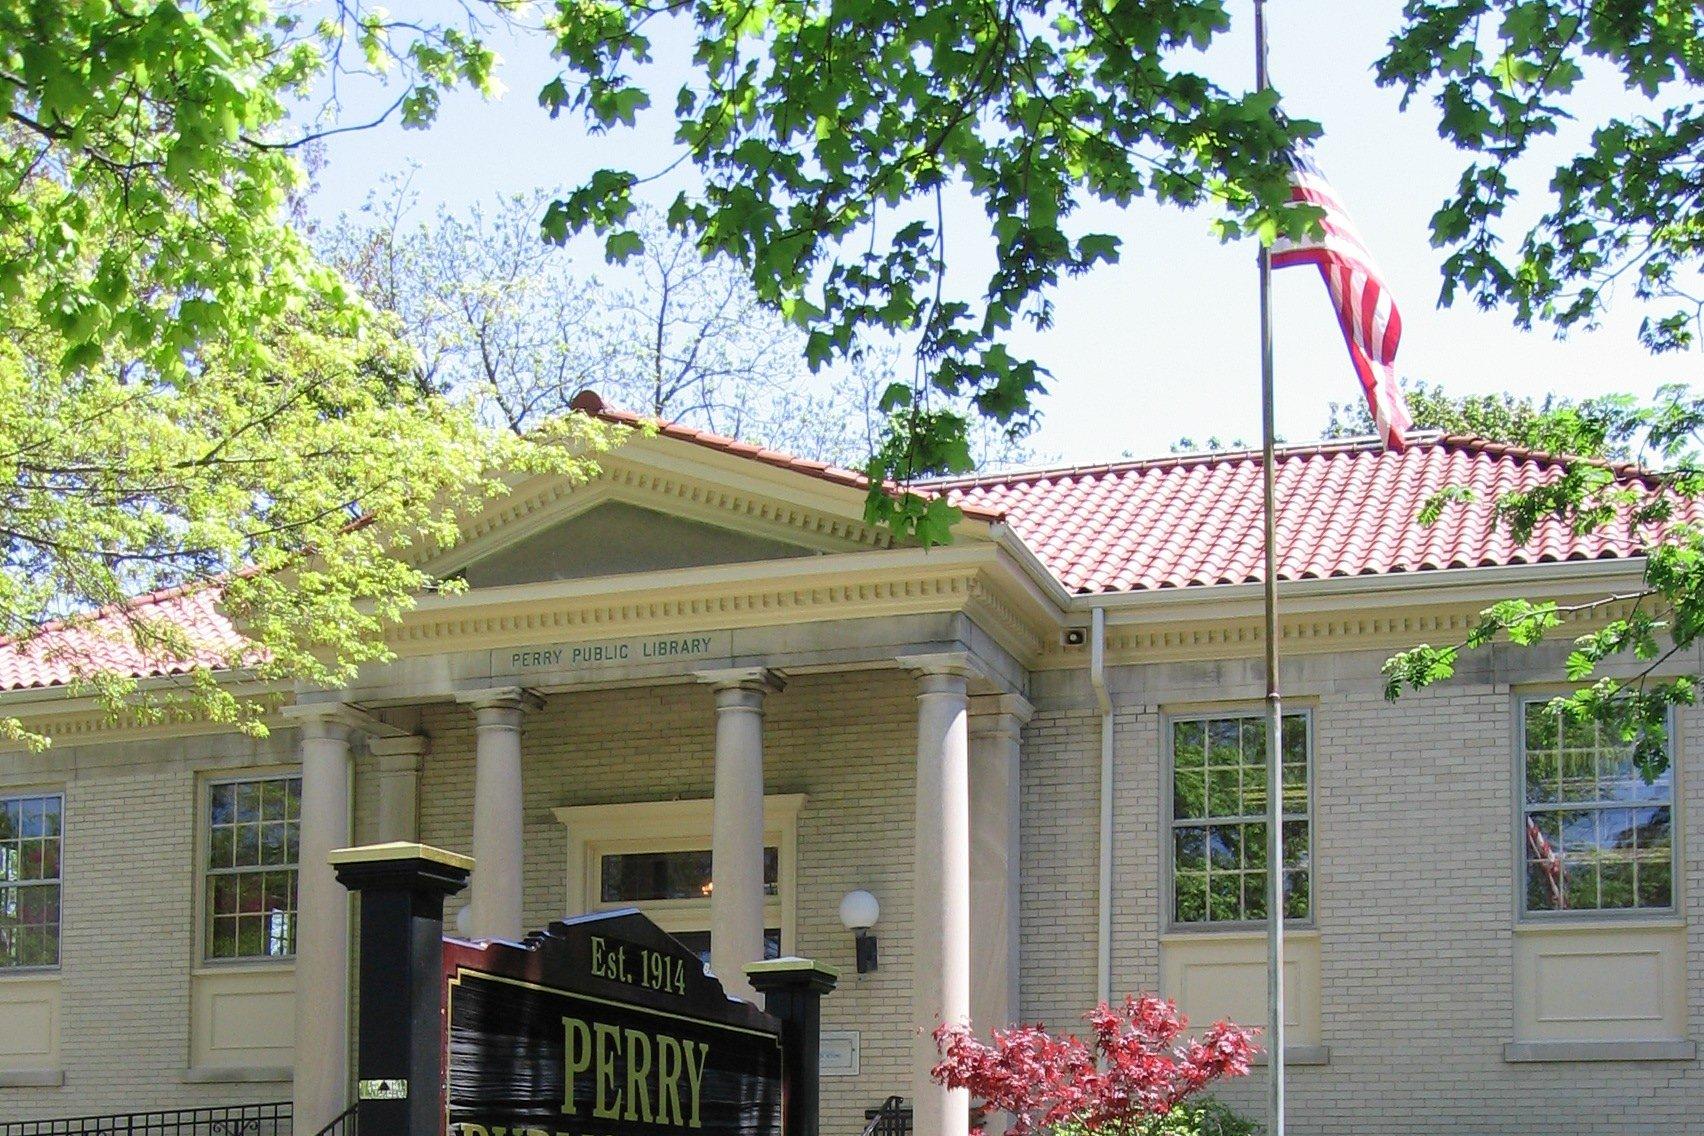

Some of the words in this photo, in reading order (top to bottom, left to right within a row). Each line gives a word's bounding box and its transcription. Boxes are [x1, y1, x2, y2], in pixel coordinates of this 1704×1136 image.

[511, 650, 563, 668] PERRY
[572, 644, 629, 664] PUBLIC
[643, 636, 712, 658] LIBRARY
[590, 936, 633, 983] Est.
[640, 949, 686, 996] 1914
[561, 1015, 710, 1129] PERRY
